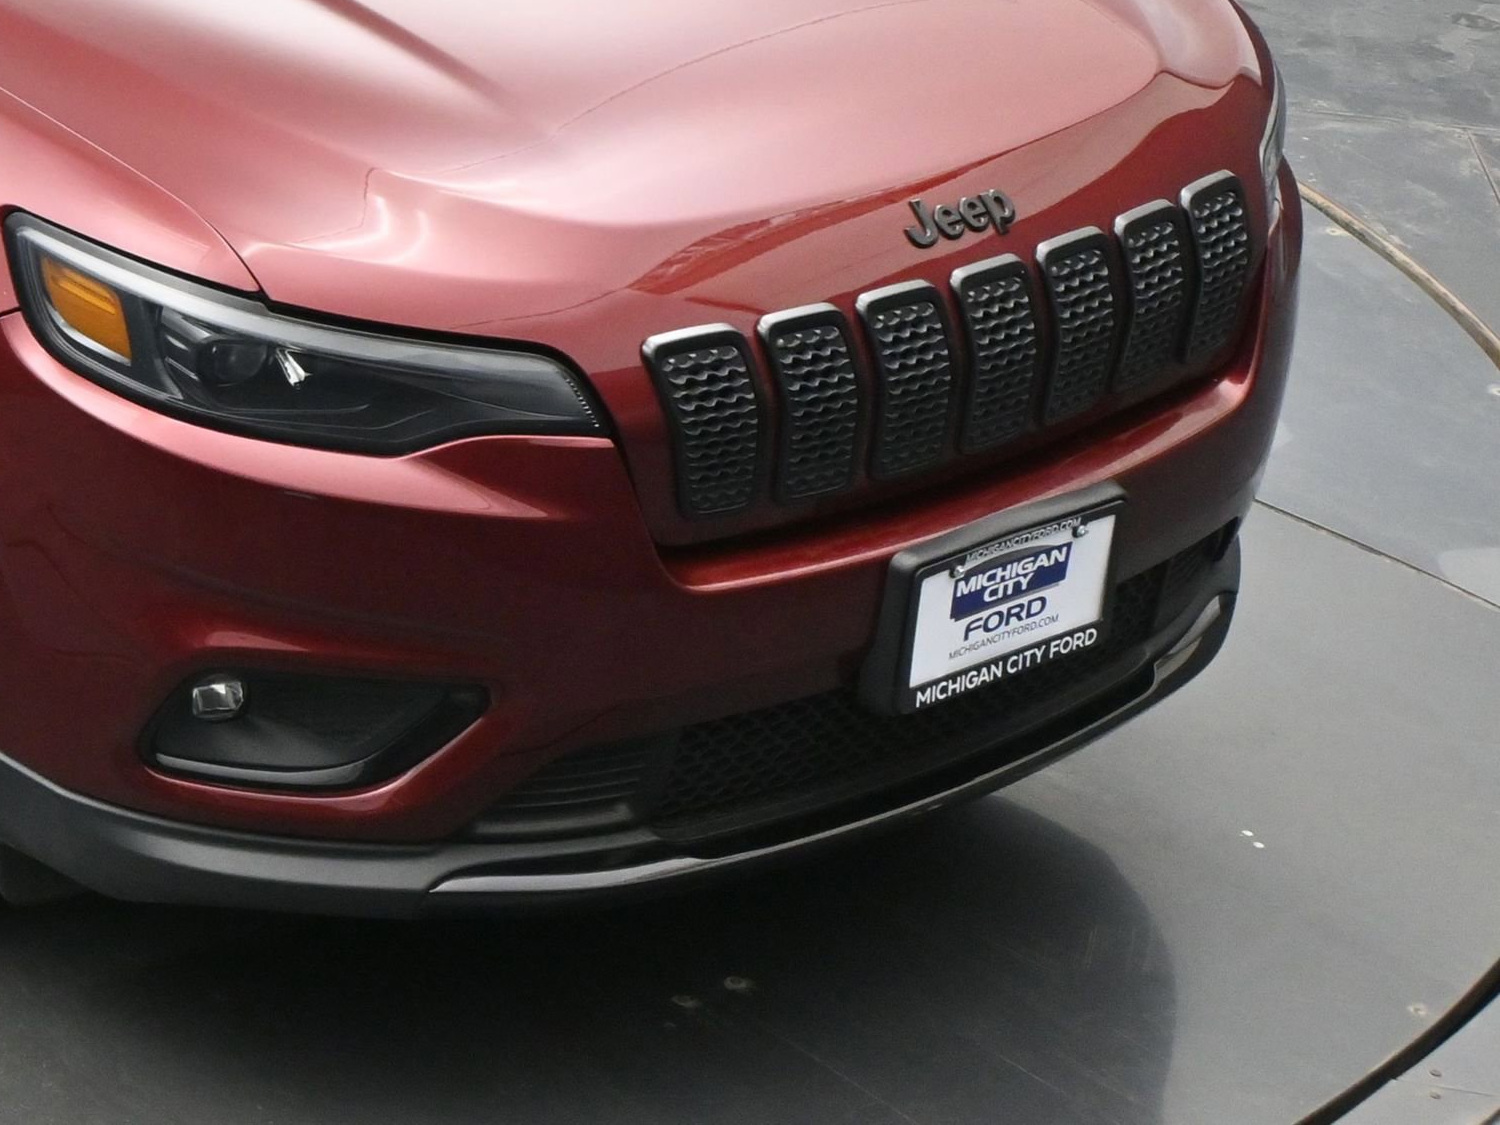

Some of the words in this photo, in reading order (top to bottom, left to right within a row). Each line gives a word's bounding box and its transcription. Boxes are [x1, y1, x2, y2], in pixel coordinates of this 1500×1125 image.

[904, 188, 1015, 249] Jeep
[956, 546, 1068, 597] MICHIGAN
[983, 572, 1034, 603] CITY
[948, 613, 1060, 660] MICHIGANCITYFORD.COM
[963, 596, 1047, 642] FORD
[915, 662, 1002, 708] MICHIGAN
[1006, 644, 1046, 675] CITY
[1049, 627, 1098, 659] FORD
